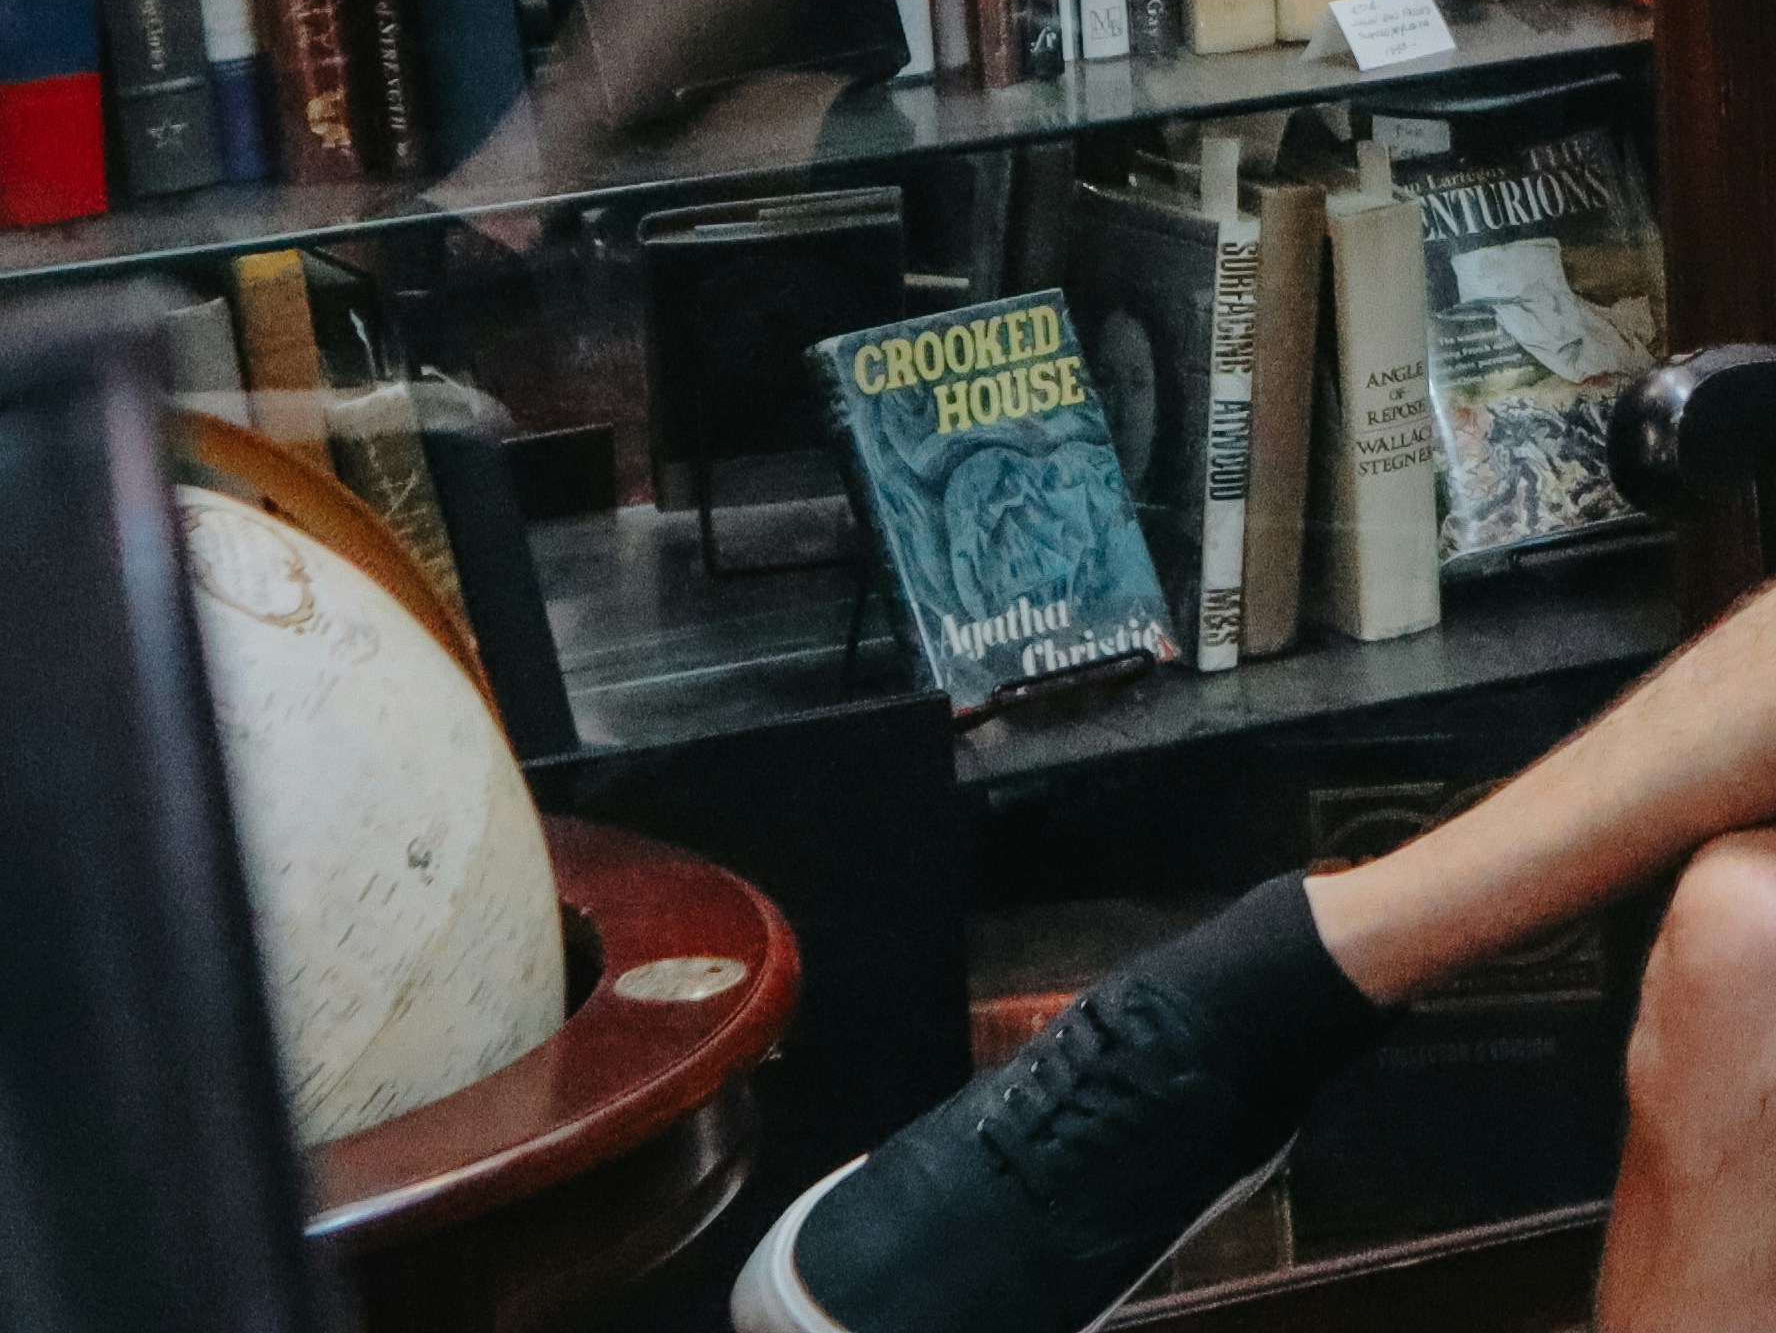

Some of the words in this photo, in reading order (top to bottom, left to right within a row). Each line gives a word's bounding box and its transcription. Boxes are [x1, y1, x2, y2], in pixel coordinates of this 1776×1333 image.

[1421, 163, 1610, 241] ENTURIONS
[1213, 241, 1262, 377] SURFACING
[853, 306, 1061, 397] CROOKED
[1366, 361, 1425, 389] ANGLE
[933, 355, 1086, 437] HOUSE
[1366, 397, 1430, 426] REPOSE
[1388, 385, 1407, 401] OF
[1208, 398, 1252, 502] ATWOOD
[938, 595, 1072, 667] Agatha
[1022, 619, 1164, 678] Christie
